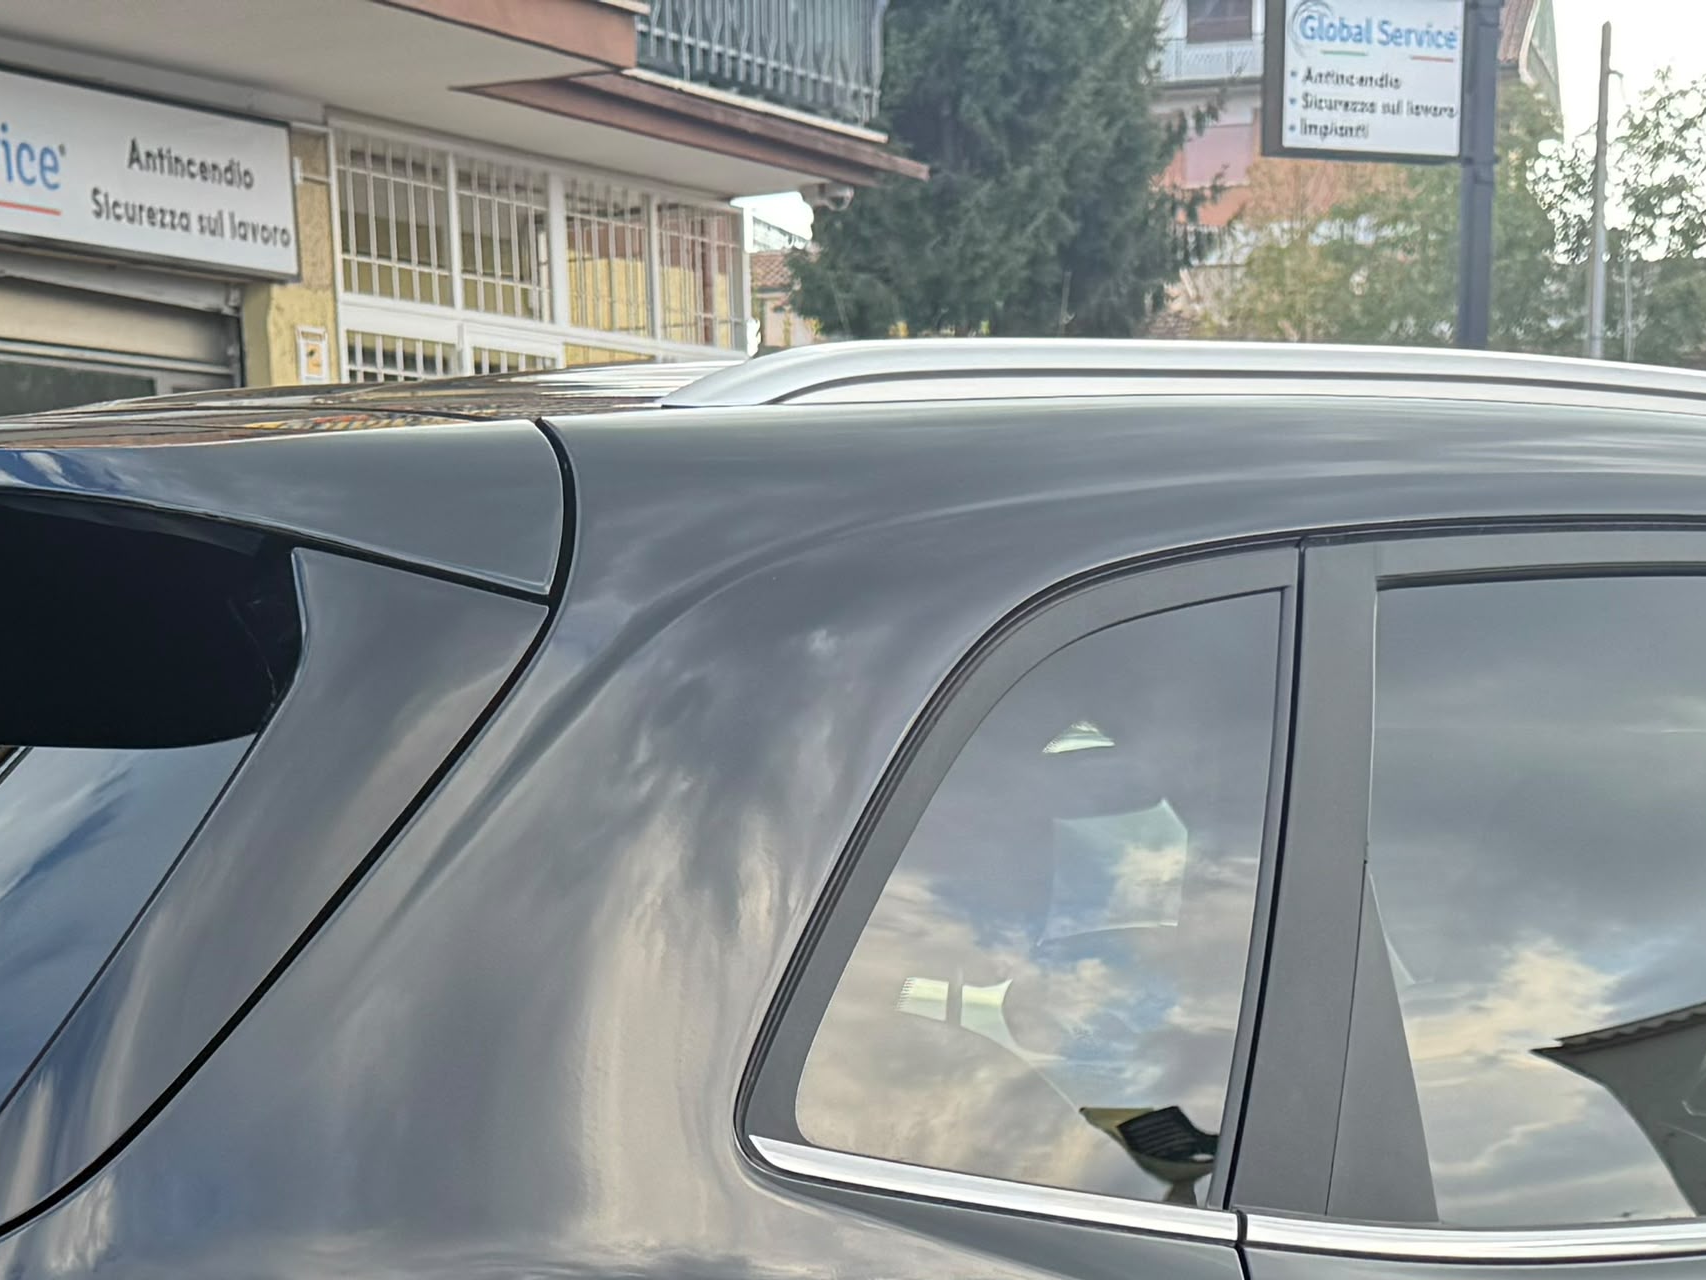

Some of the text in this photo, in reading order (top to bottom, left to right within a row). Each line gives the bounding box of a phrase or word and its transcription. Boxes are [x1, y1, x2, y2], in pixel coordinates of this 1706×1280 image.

[1299, 14, 1458, 49] Global Service
[126, 137, 255, 190] Antincendio
[90, 186, 292, 248] Sicurezza sul lavoro
